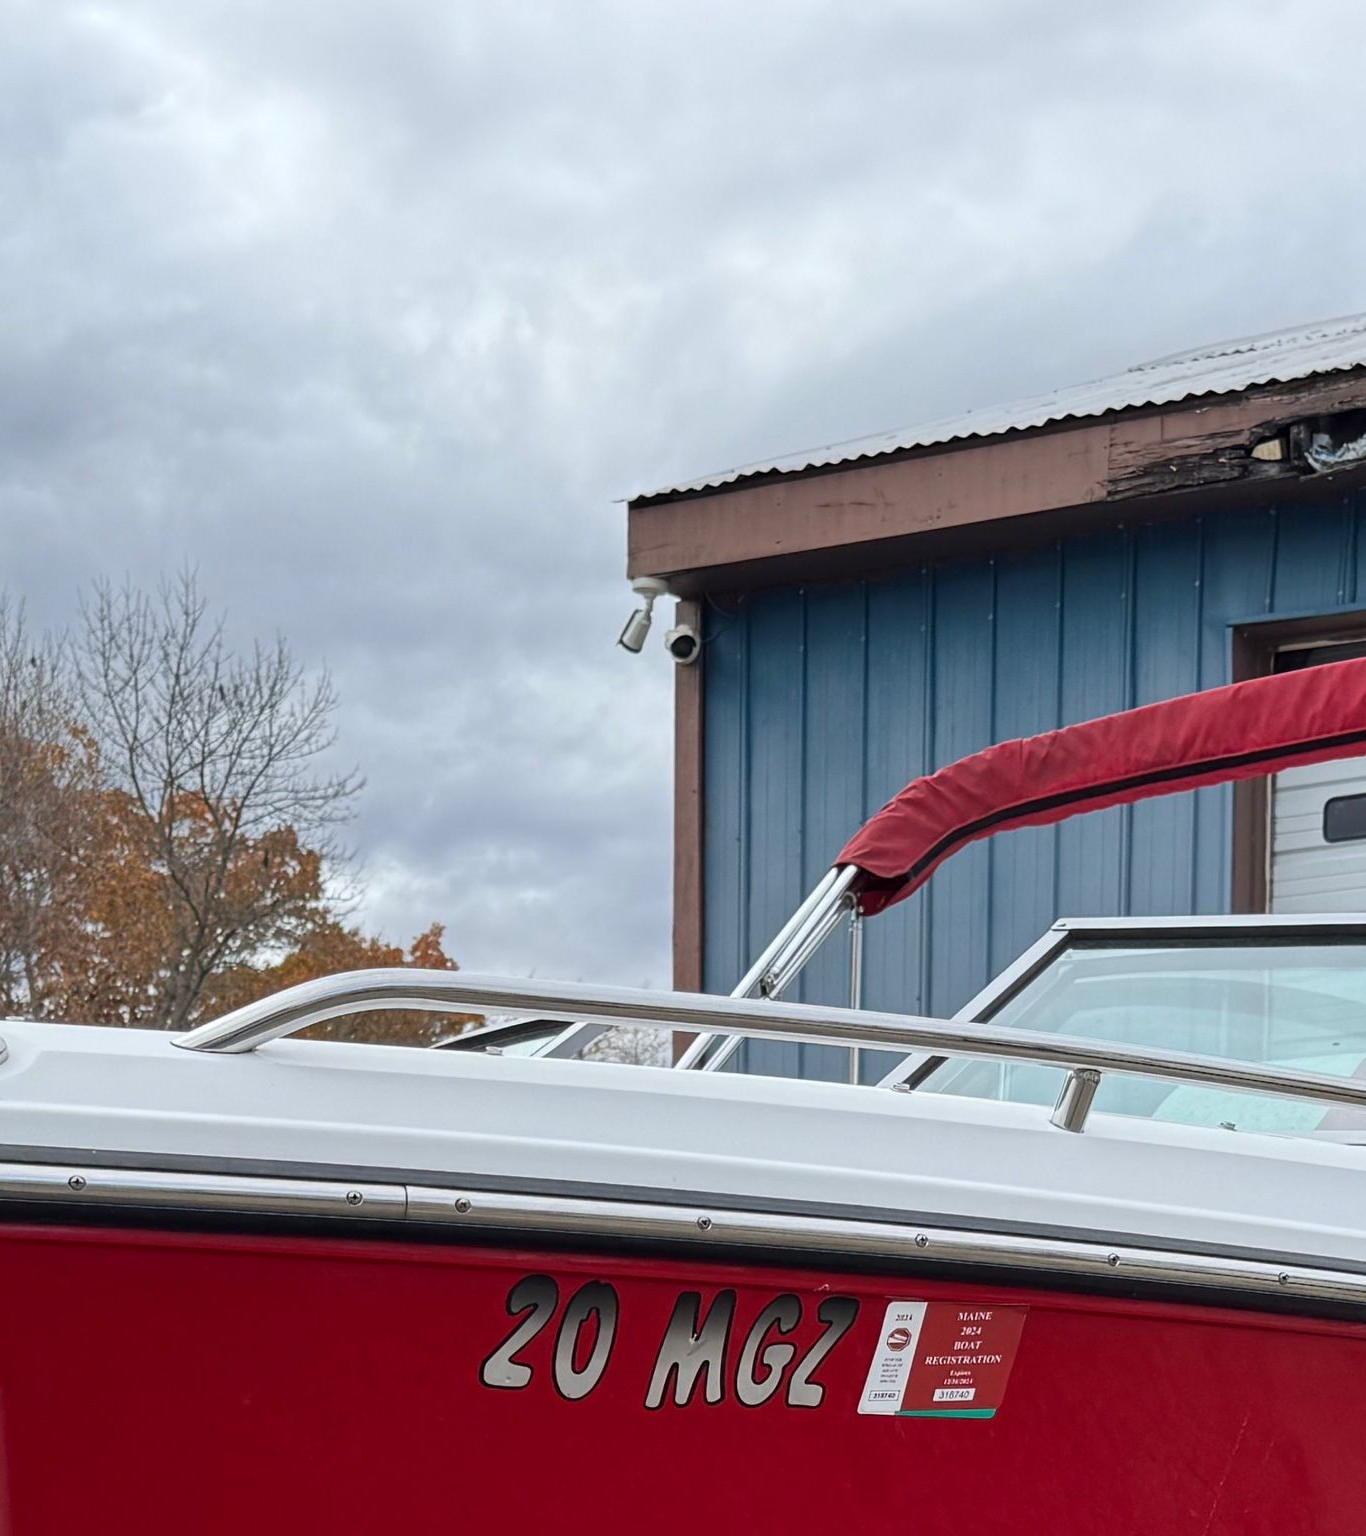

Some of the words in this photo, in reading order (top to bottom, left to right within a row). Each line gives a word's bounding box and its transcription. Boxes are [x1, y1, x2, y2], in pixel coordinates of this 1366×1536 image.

[957, 1311, 993, 1321] MAINE
[960, 1326, 982, 1336] 2024
[479, 1272, 619, 1401] 20
[643, 1288, 861, 1411] MGZ
[954, 1340, 983, 1351] BOAT
[924, 1354, 1003, 1366] REGISTRATION
